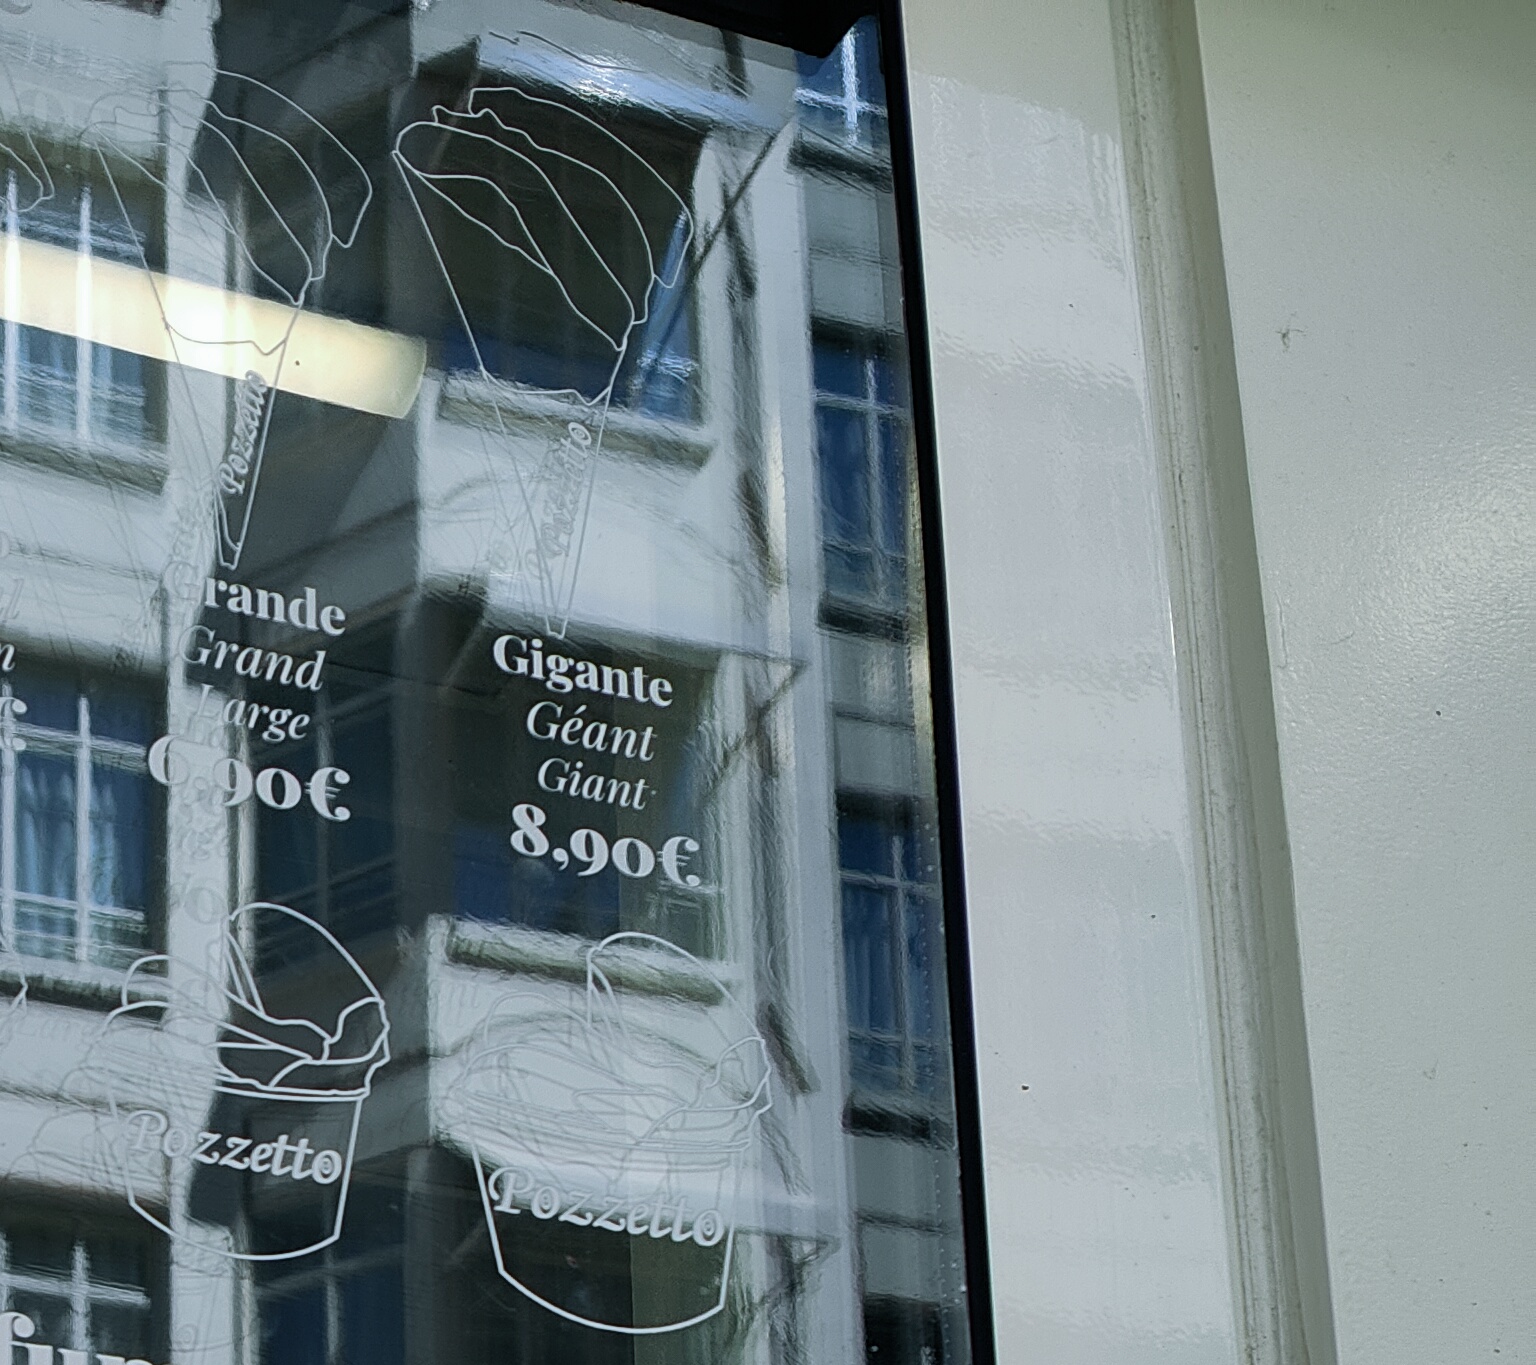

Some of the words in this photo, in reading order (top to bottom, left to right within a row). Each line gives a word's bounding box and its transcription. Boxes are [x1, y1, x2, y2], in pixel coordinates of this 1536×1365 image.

[179, 623, 326, 693] Grand
[492, 633, 674, 708] Gigante
[198, 682, 311, 744] Large
[526, 699, 657, 763] Géant
[537, 756, 653, 812] Giant
[510, 803, 701, 888] 8,90€
[125, 1109, 343, 1185] Pozzetto
[488, 1164, 726, 1248] Pozzetto
